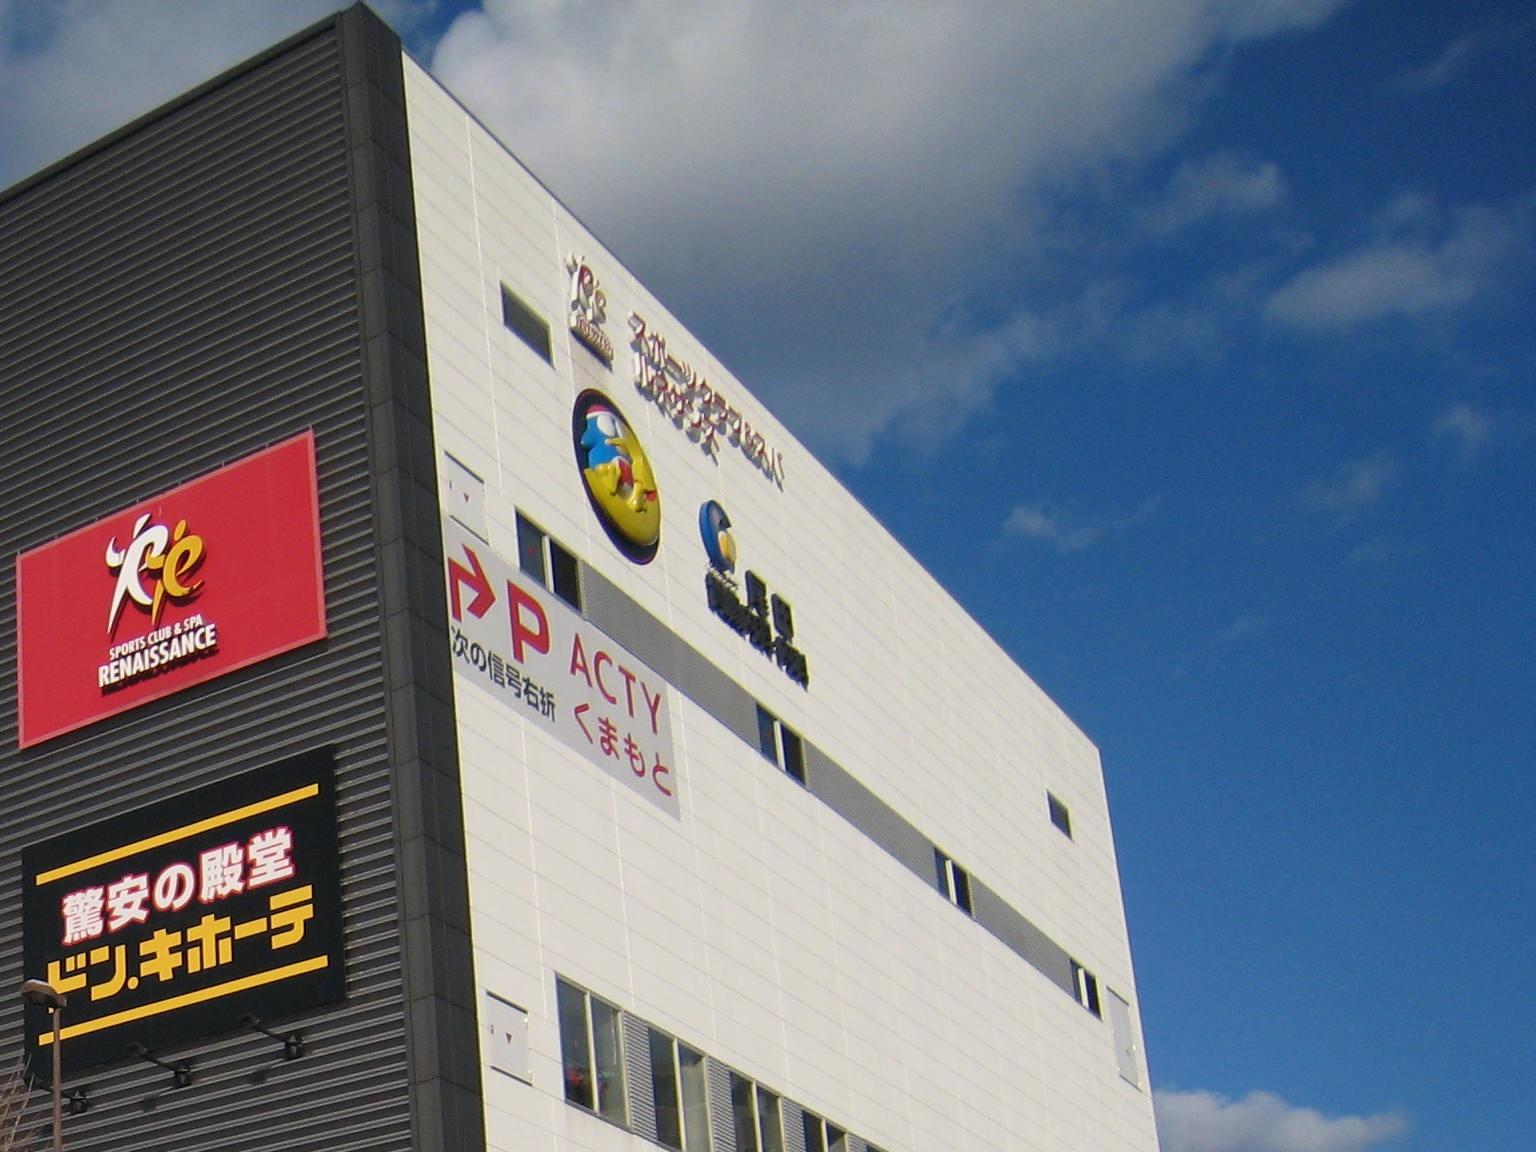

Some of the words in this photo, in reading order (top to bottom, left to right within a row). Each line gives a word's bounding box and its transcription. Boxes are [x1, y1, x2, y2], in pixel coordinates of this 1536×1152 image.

[98, 623, 216, 688] RENAISSANCE
[109, 635, 146, 660] SPORTS
[147, 626, 172, 645] CLUB
[174, 622, 182, 636] &
[184, 613, 204, 631] SPA
[451, 626, 556, 722] 次の信号右折
[507, 579, 551, 664] P
[570, 632, 661, 735] ACTY
[574, 703, 672, 796] くまもと
[62, 827, 295, 944] 驚安の殿堂
